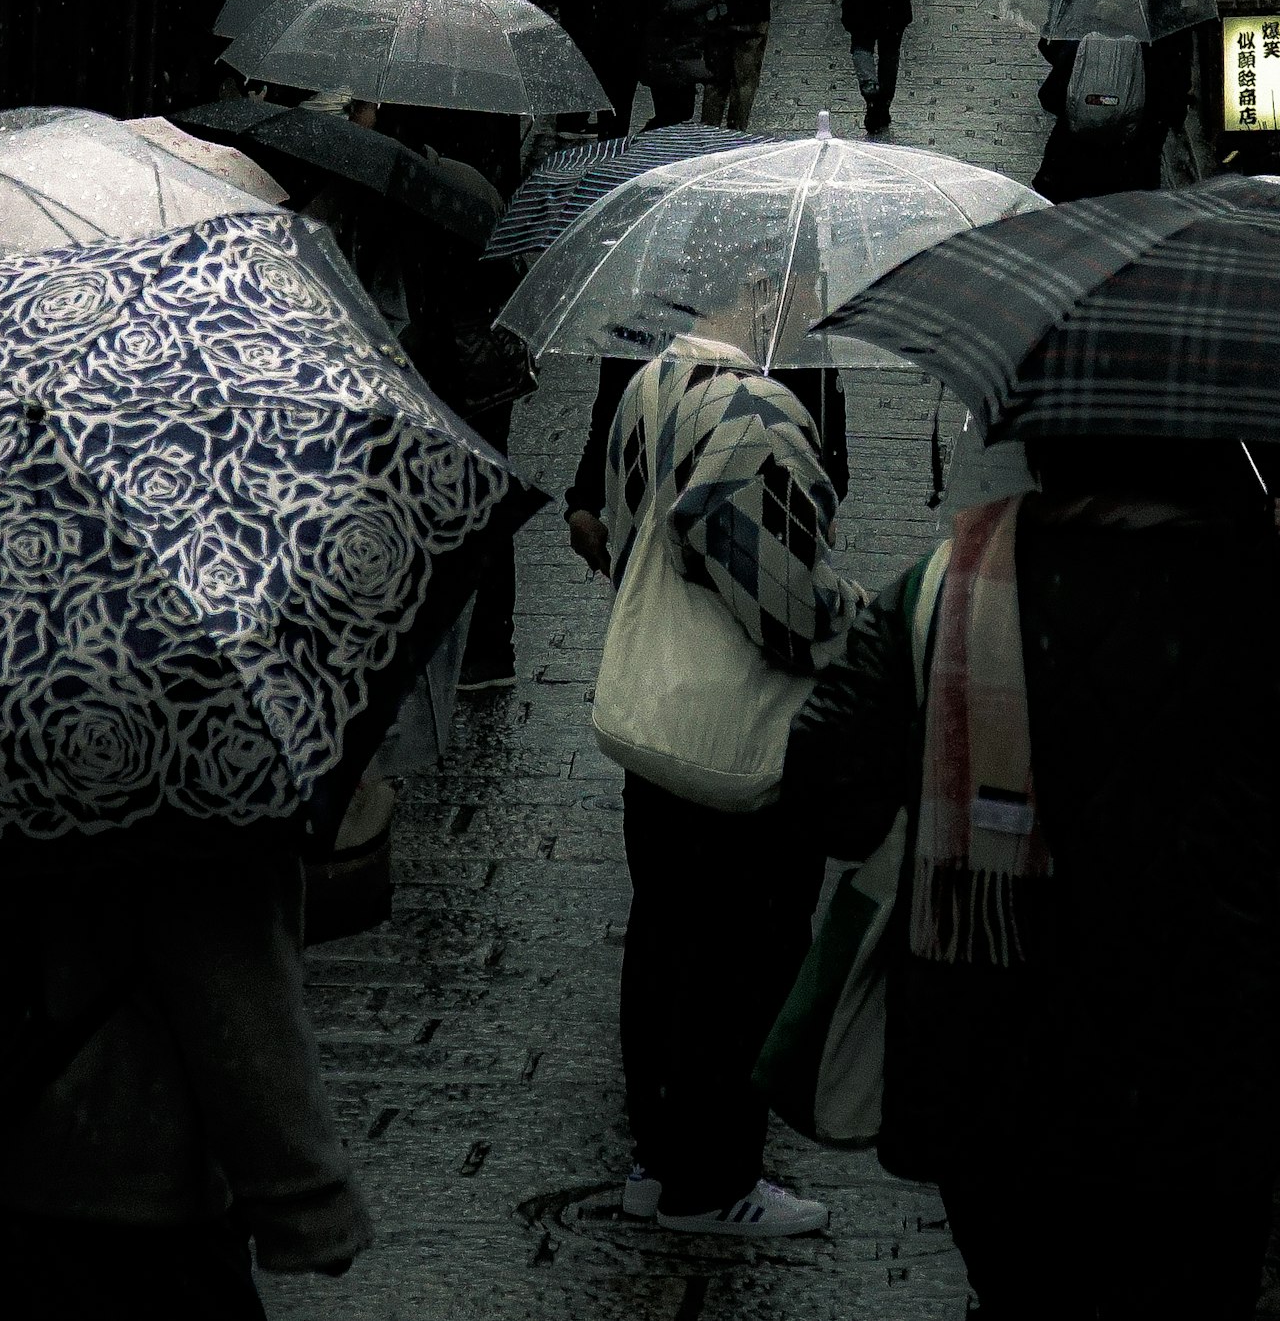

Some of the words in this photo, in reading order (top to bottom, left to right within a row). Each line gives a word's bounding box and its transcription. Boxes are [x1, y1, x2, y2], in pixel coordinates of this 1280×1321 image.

[1262, 21, 1280, 59] 爆笑
[1237, 32, 1257, 125] 似顔絵商店
